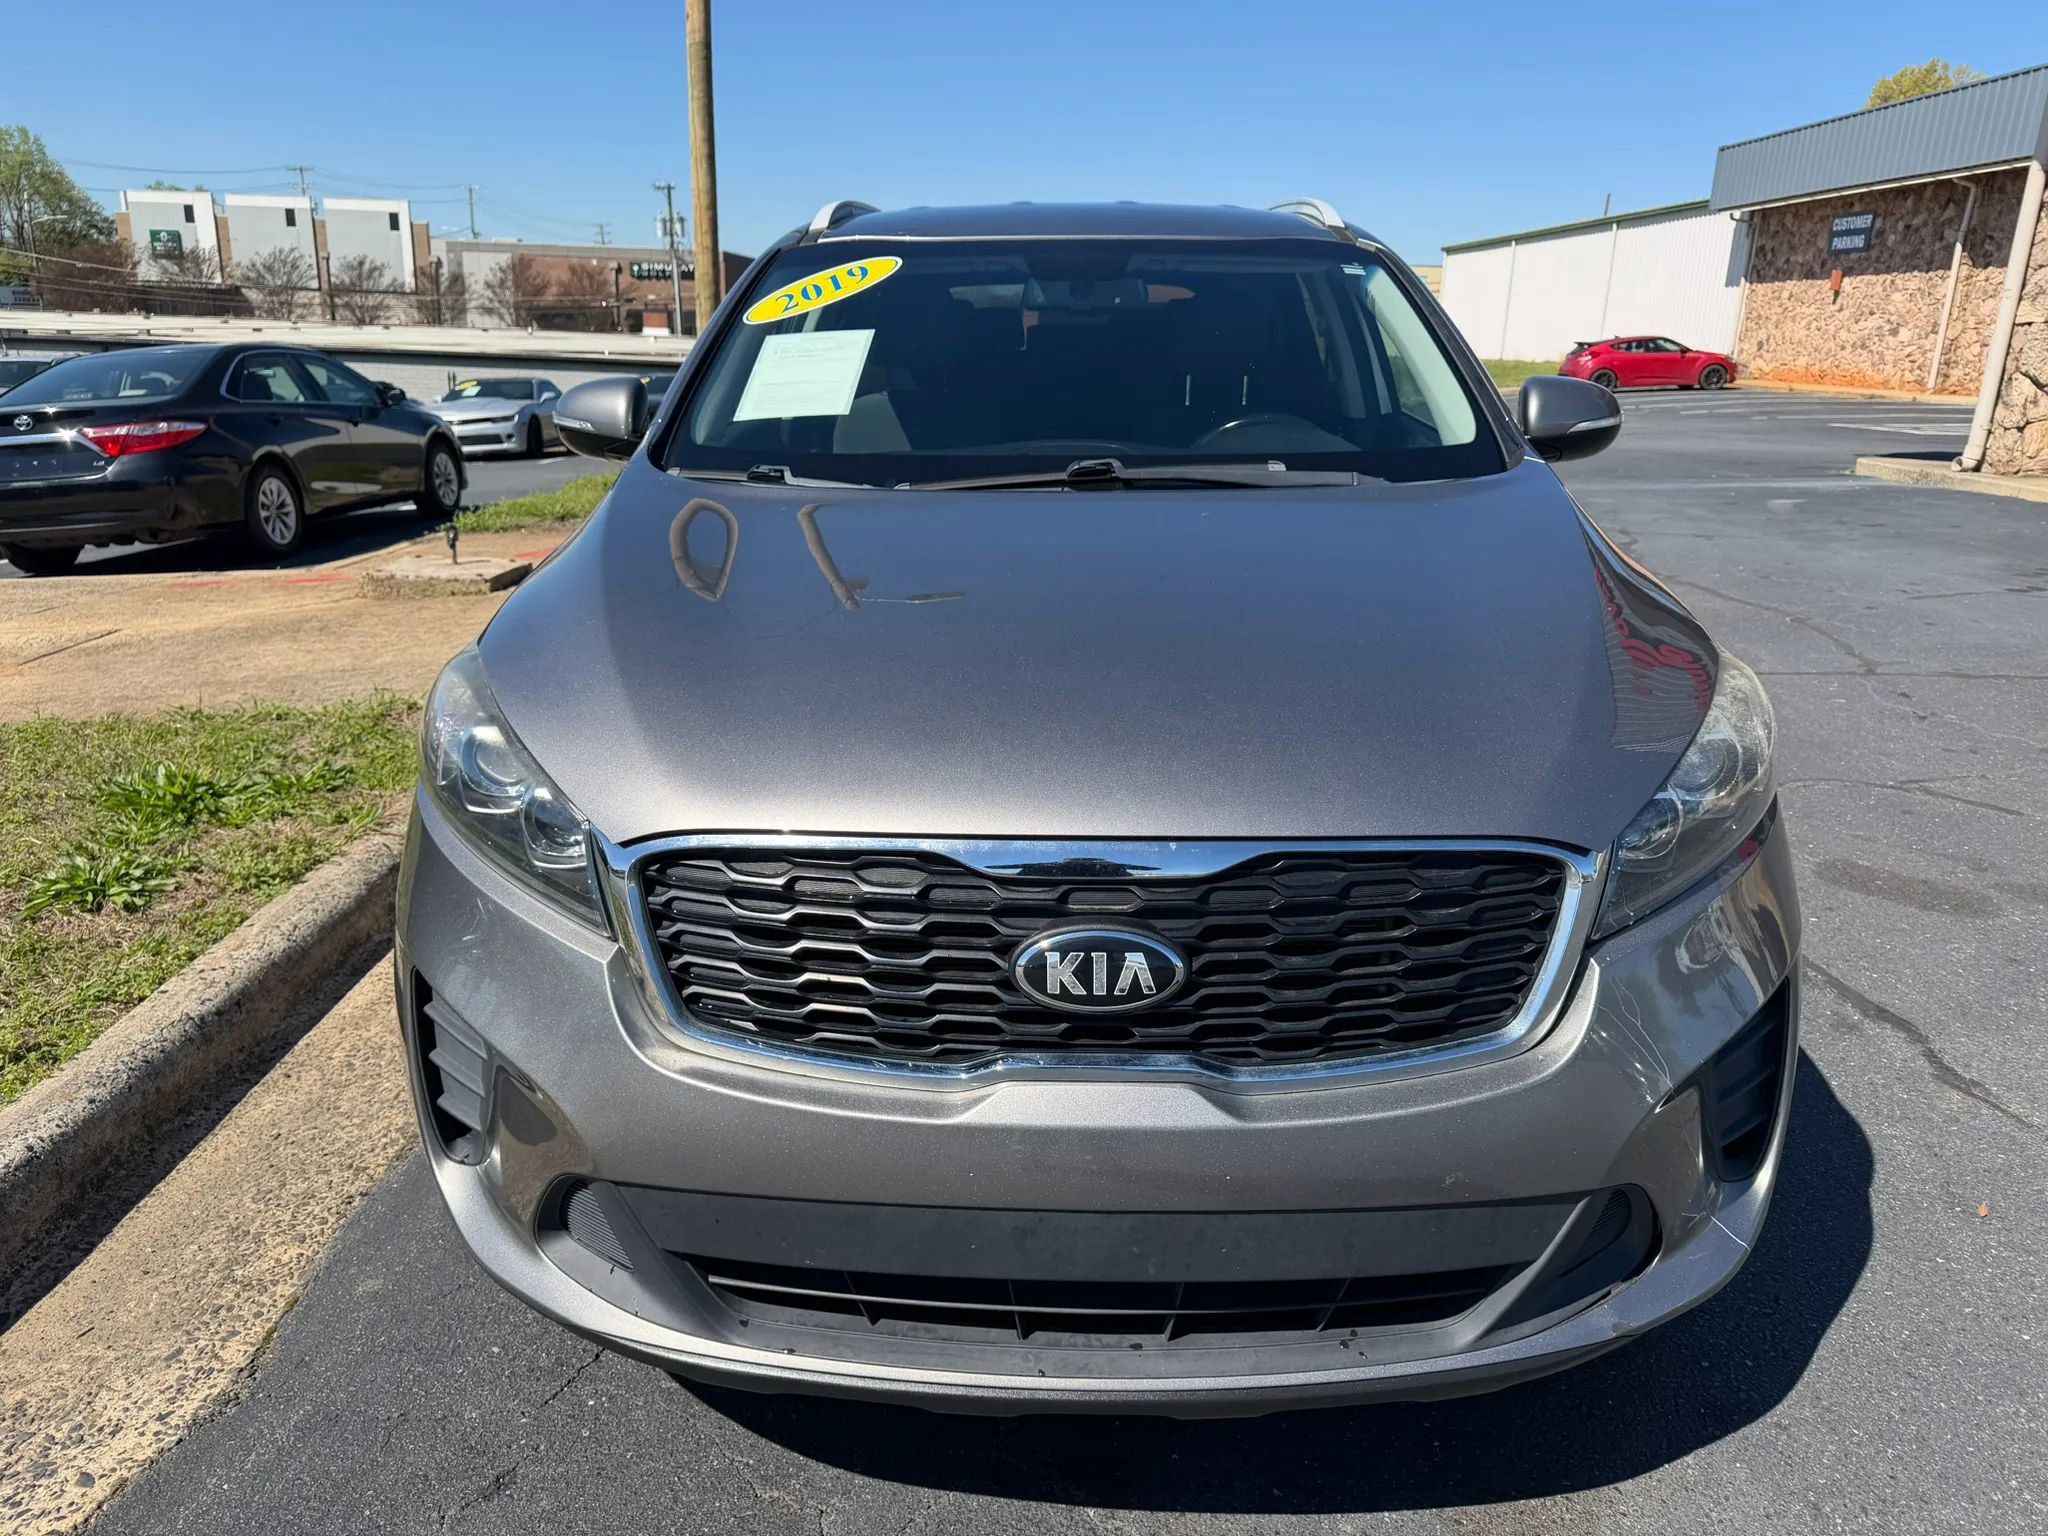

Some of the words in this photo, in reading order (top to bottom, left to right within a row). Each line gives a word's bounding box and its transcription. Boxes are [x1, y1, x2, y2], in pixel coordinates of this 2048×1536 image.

[1833, 214, 1873, 231] CUSTOMER
[1832, 234, 1865, 250] PARKING
[776, 266, 869, 313] 2019
[1045, 952, 1156, 995] KIA
